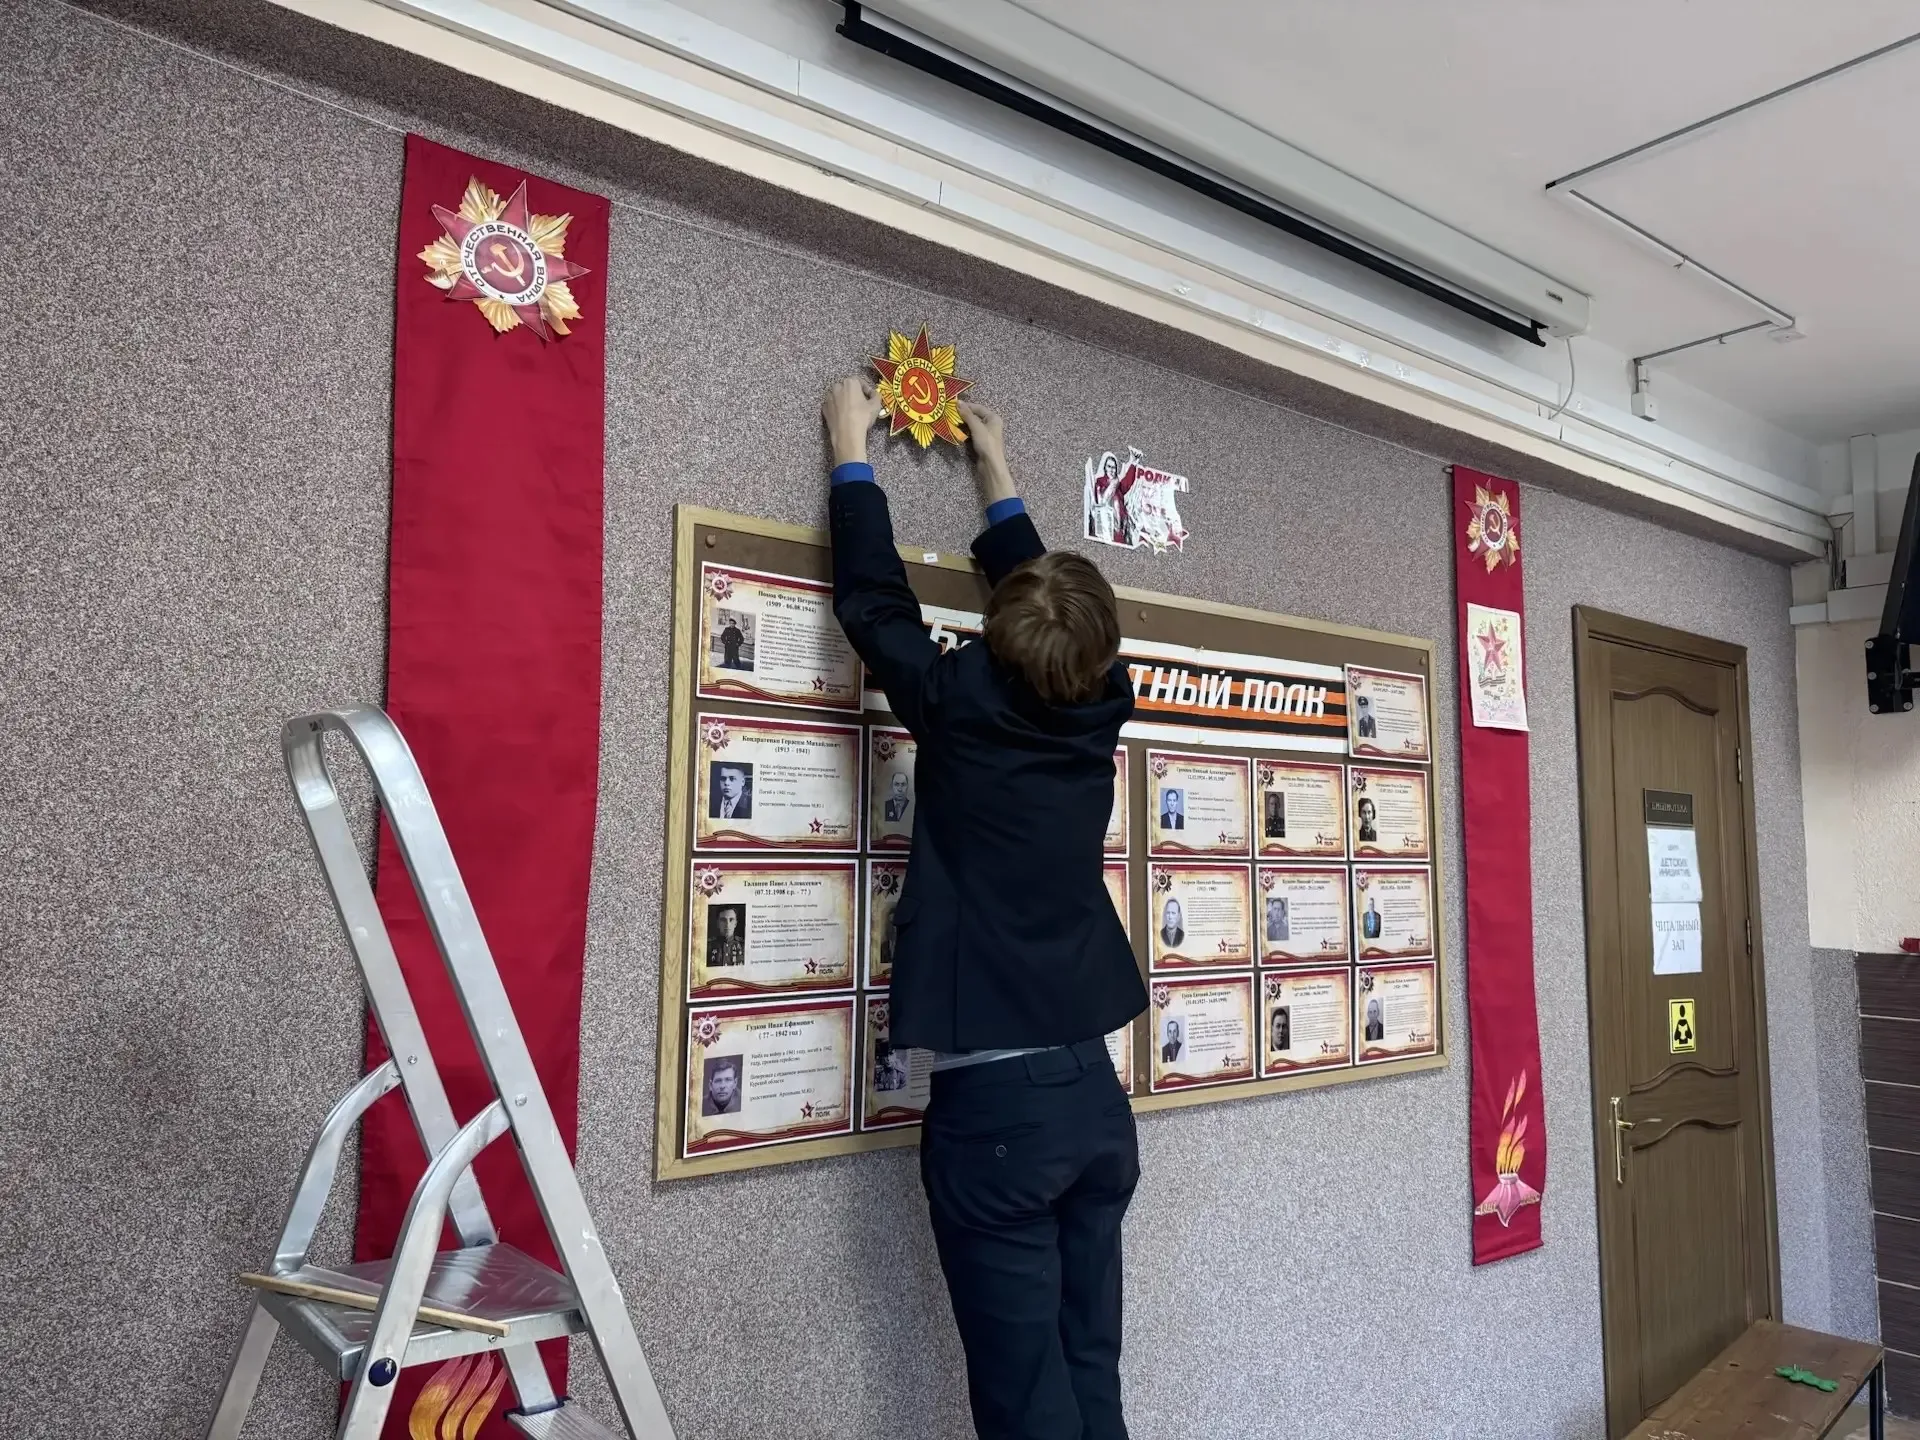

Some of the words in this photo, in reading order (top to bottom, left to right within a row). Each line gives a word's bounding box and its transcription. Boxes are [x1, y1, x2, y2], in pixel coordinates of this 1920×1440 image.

[462, 223, 542, 288] ОТЕЧЕСТВЕННАЯ
[516, 265, 545, 303] ВОЙНА
[894, 359, 943, 413] ОТЕЧЕСТВЕННАЯ
[930, 387, 946, 420] ВОЙНА
[1240, 677, 1326, 718] ПОЛК
[1655, 918, 1699, 932] ЧИТАЛЬНЫЙ
[1672, 939, 1685, 951] ЗАЛ
